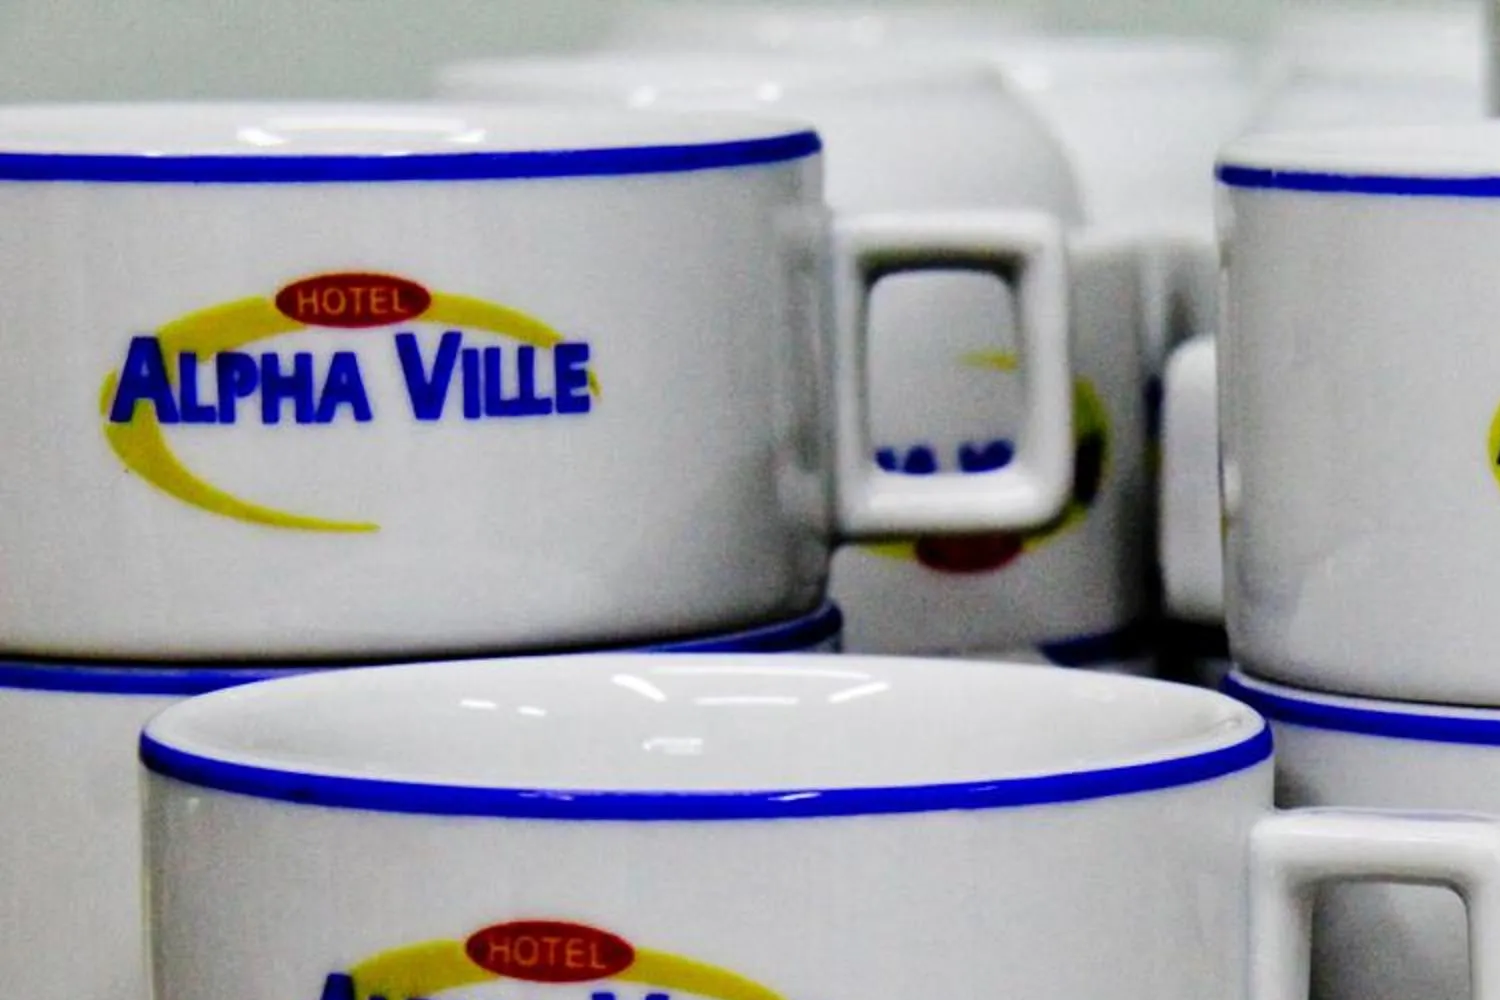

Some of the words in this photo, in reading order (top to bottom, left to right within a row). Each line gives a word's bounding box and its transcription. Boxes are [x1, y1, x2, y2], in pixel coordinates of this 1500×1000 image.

[296, 286, 409, 317] HOTEL
[110, 336, 373, 426] ALPHA
[394, 330, 592, 422] VILLE
[488, 935, 607, 970] HOTEL
